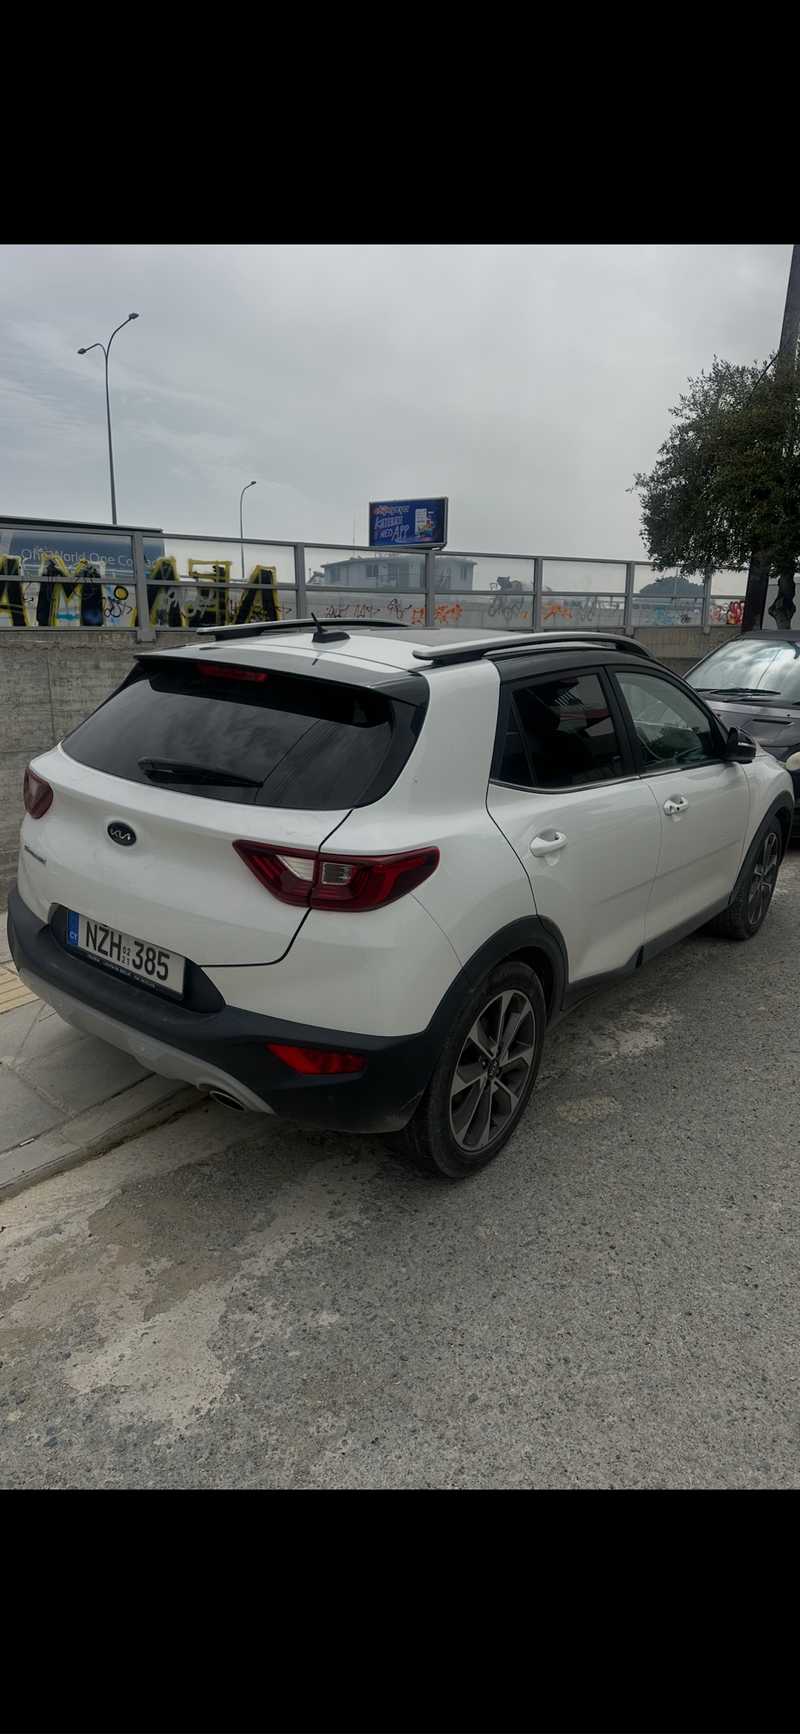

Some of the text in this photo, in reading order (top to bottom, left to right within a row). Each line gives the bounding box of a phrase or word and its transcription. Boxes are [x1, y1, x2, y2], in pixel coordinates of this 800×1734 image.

[21, 548, 48, 561] On
[69, 931, 78, 940] CY
[86, 920, 122, 962] NZH
[131, 940, 171, 981] 385
